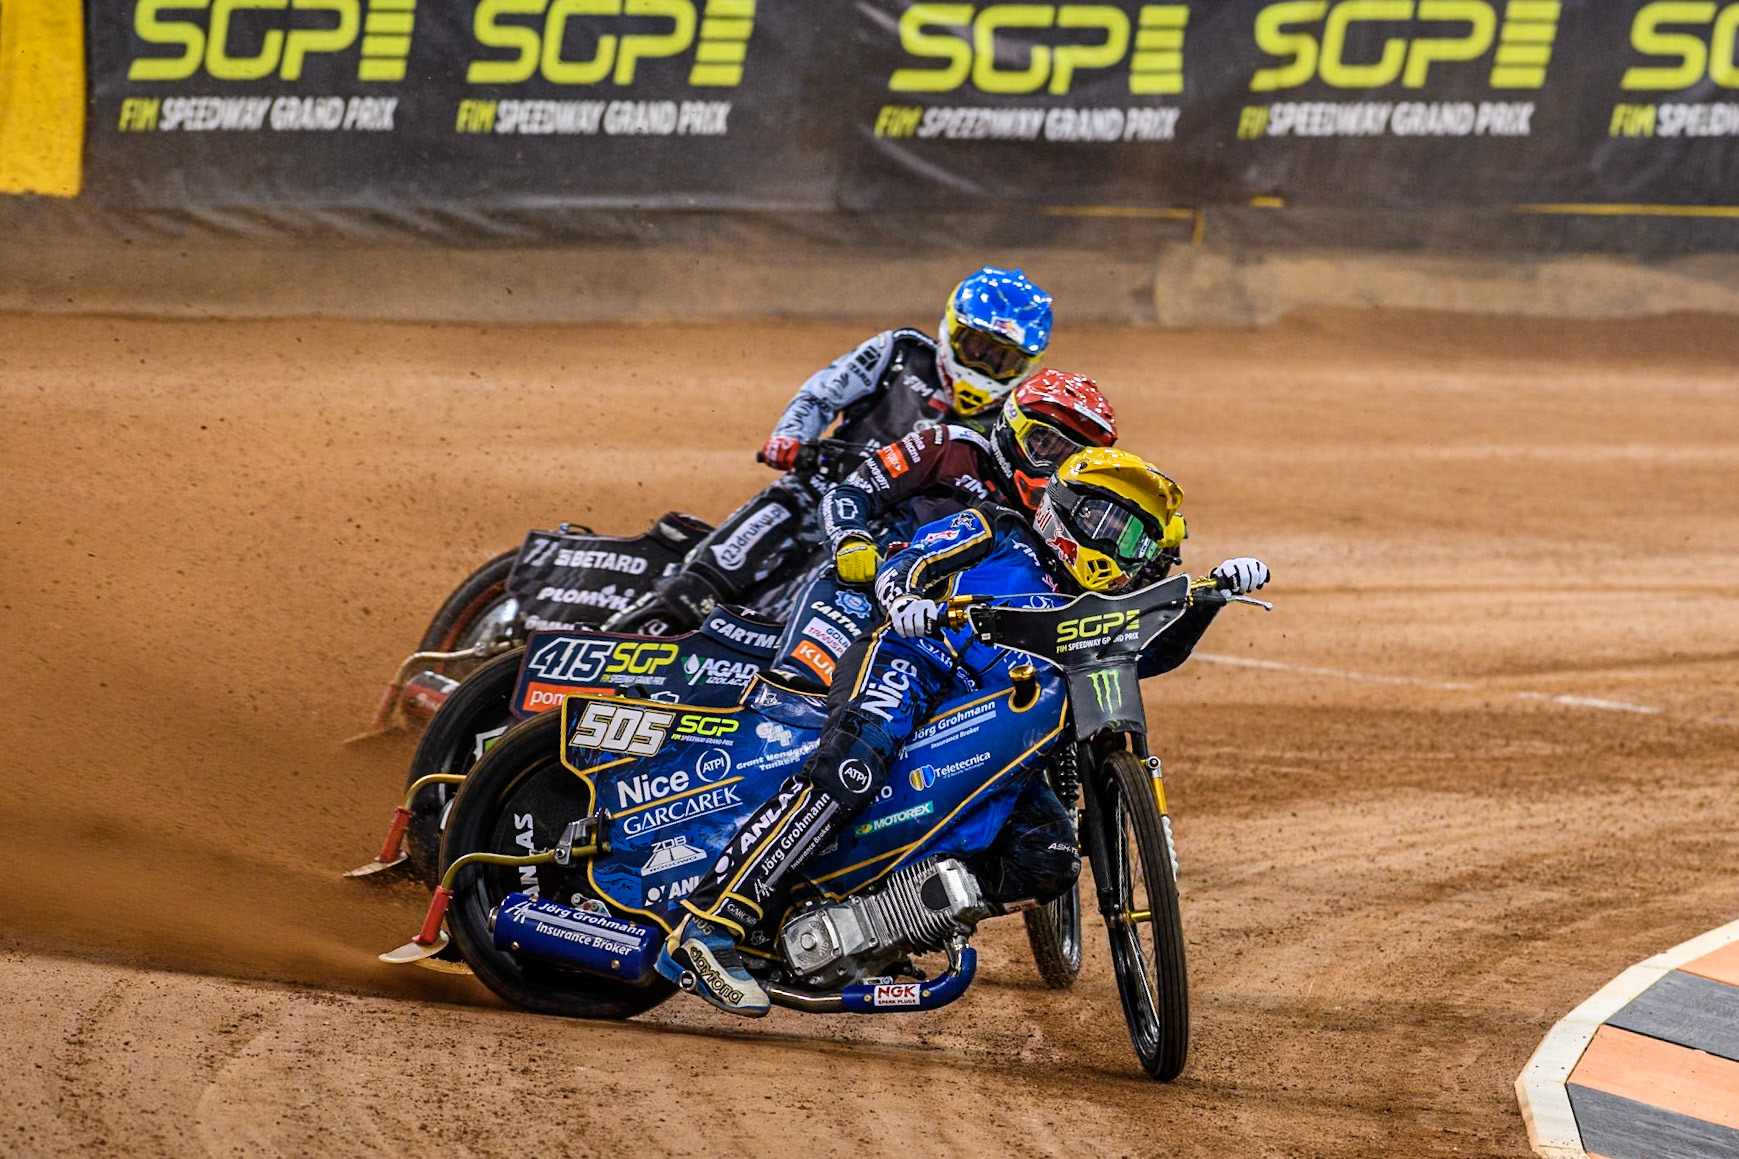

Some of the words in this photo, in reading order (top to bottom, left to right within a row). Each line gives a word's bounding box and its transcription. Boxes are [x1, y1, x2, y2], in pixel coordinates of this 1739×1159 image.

[127, 0, 361, 80] SGP
[466, 0, 698, 85] SGP
[888, 4, 1130, 94] SGP
[1250, 0, 1497, 91] SGP
[118, 97, 160, 131] FIM
[159, 97, 272, 131] SPEEDWAY
[270, 97, 345, 131] GRAND
[343, 97, 398, 131] PRIX
[455, 99, 497, 133] FIM
[494, 99, 605, 134] SPEEDWAY
[603, 100, 678, 135] GRAND
[677, 101, 732, 134] PRIX
[874, 106, 922, 138] FIM
[917, 106, 1045, 139] SPEEDWAY
[1044, 107, 1124, 141] GRAND
[1123, 107, 1180, 141] PRIX
[1266, 102, 1392, 136] SPEEDWAY
[1390, 102, 1476, 136] GRAND
[1474, 102, 1535, 136] PRIX
[1609, 103, 1656, 138] FIM
[955, 474, 989, 500] FIM
[1056, 611, 1125, 643] SGP
[1068, 640, 1101, 651] SPEEDWAY
[1124, 632, 1139, 640] PRIX
[528, 637, 617, 682] 415
[605, 642, 679, 674] SGP
[861, 659, 918, 722] Nice
[568, 701, 676, 757] 505
[676, 715, 739, 736] SGP
[937, 701, 996, 730] Grohmann
[702, 757, 726, 774] ATPI
[736, 756, 765, 770] Grant
[843, 766, 867, 785] ATPI
[934, 751, 991, 778] Teletecnica
[616, 770, 690, 808] Nice
[623, 784, 742, 834] GARCAREK
[873, 802, 932, 830] MOTOREX
[651, 835, 687, 853] ZDB
[761, 842, 787, 875] Jörg
[780, 792, 831, 850] Grohmann
[514, 813, 541, 898] ANAS
[538, 902, 570, 919] Jörg
[572, 911, 646, 937] Grohmann
[535, 921, 592, 946] Insurance
[592, 936, 633, 957] Broker
[689, 945, 745, 1005] daytona
[877, 984, 917, 999] NGK
